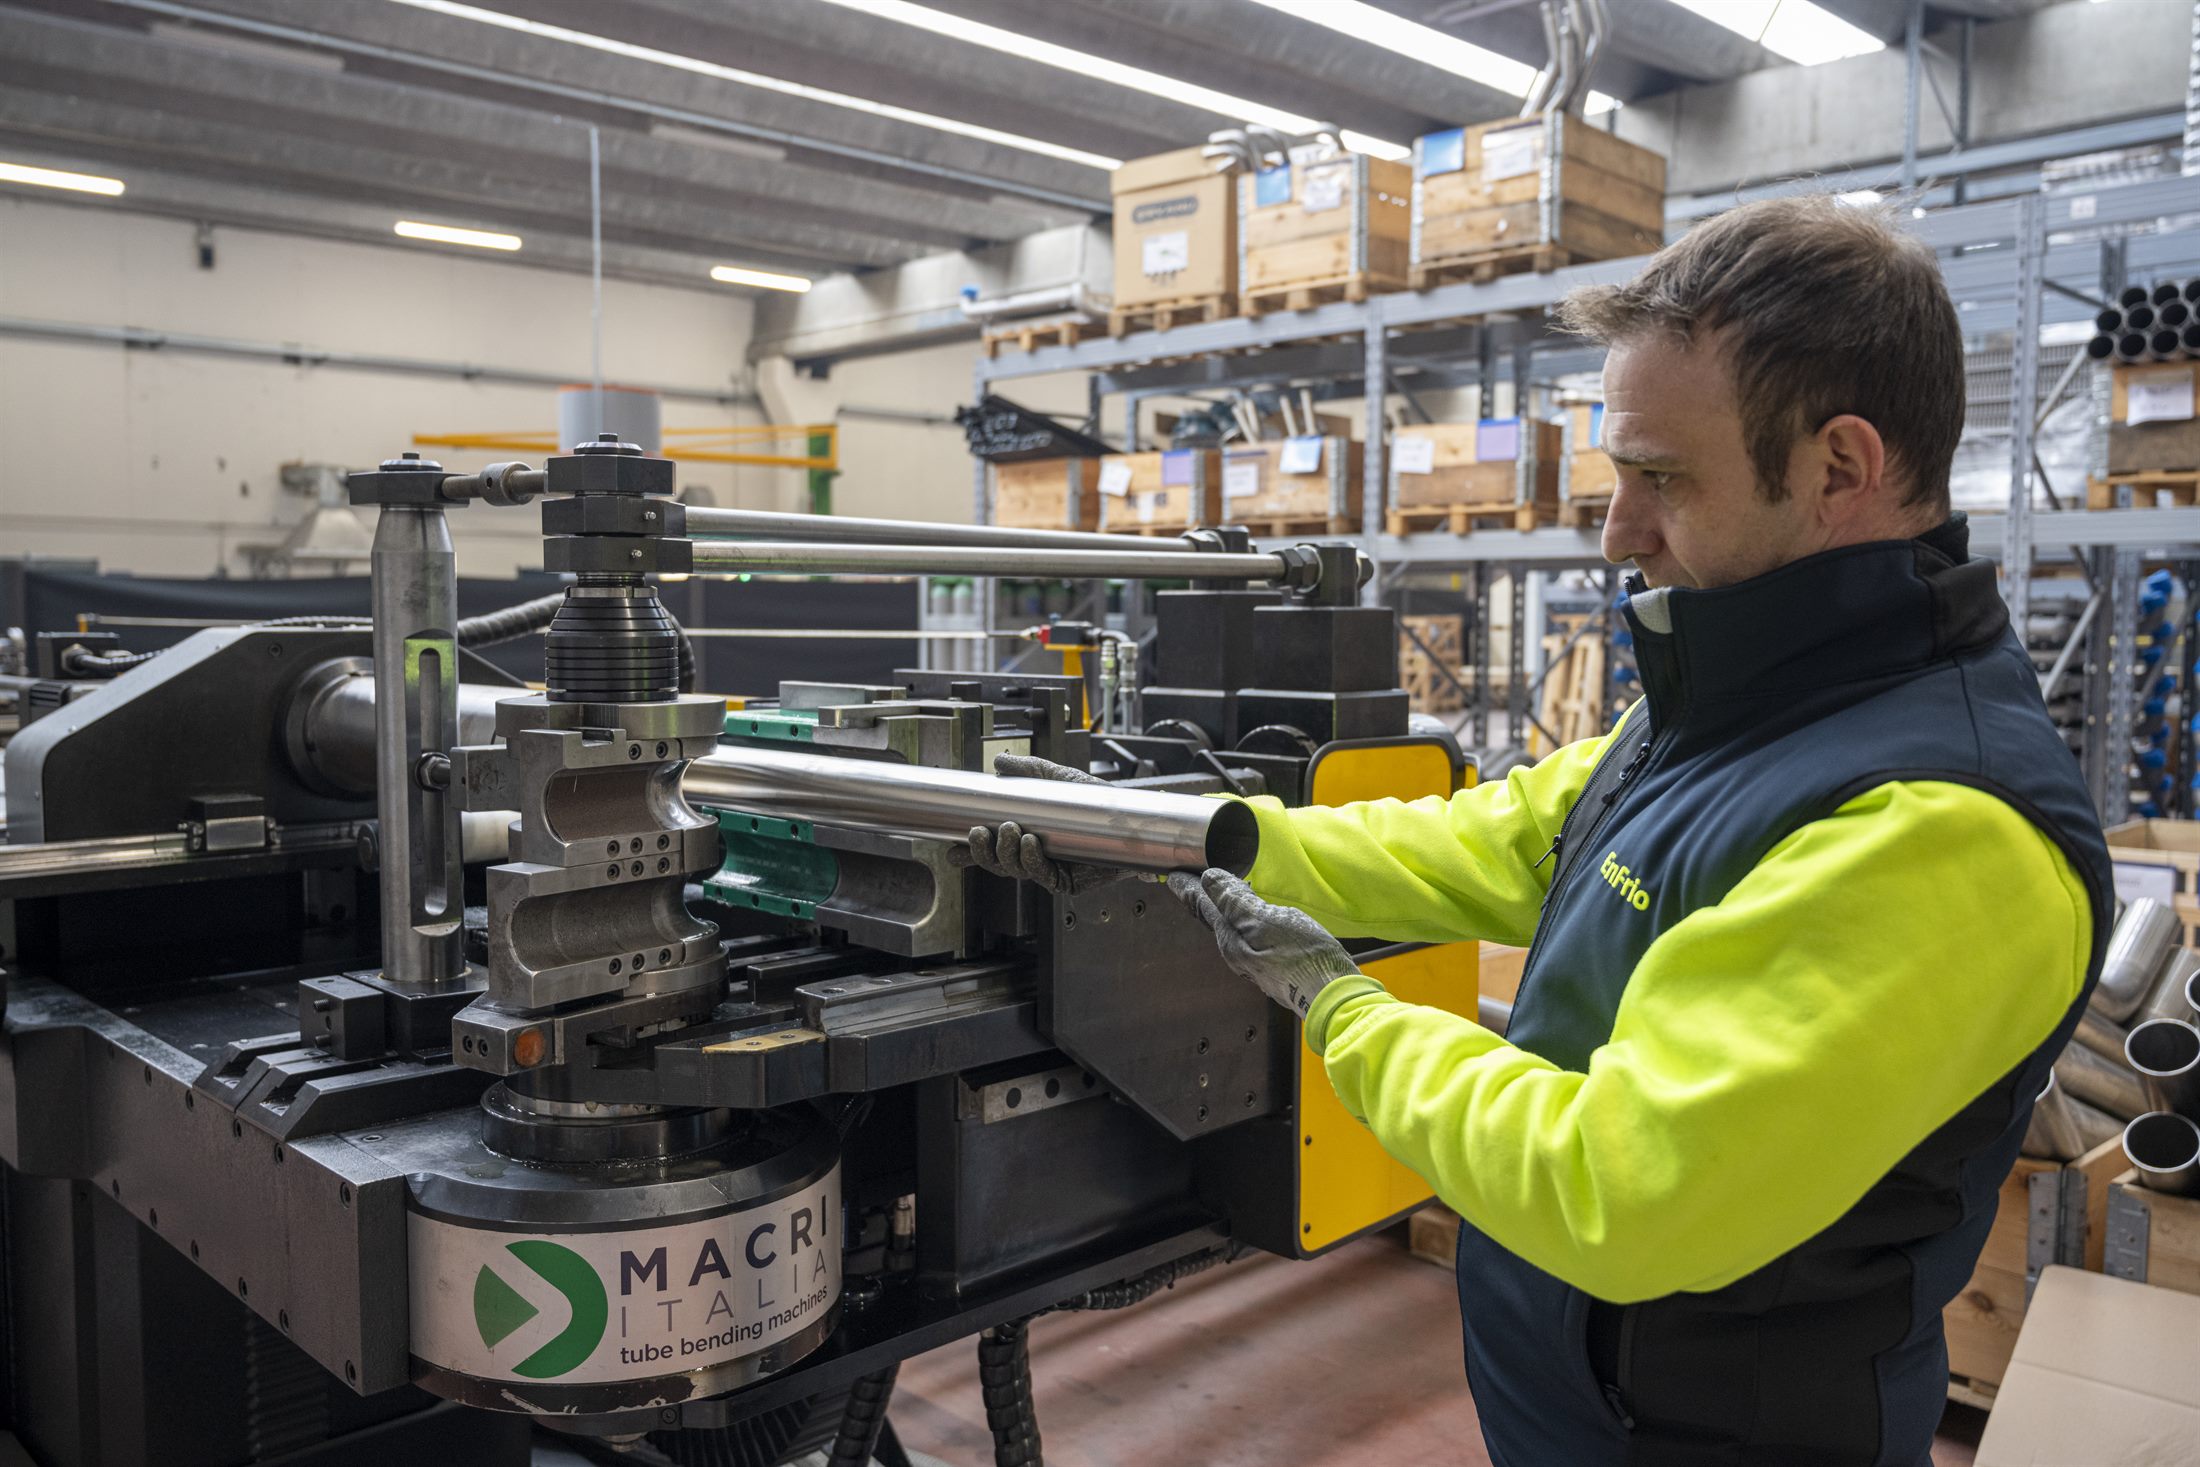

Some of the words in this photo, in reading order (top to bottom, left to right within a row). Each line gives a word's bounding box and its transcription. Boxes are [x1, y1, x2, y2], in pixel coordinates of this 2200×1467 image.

[1600, 851, 1650, 911] EnFrio
[620, 1194, 827, 1296] MACRI
[620, 1343, 673, 1364] tube
[680, 1320, 762, 1356] bending
[768, 1285, 827, 1331] machines
[621, 1248, 827, 1338] ITALIA
